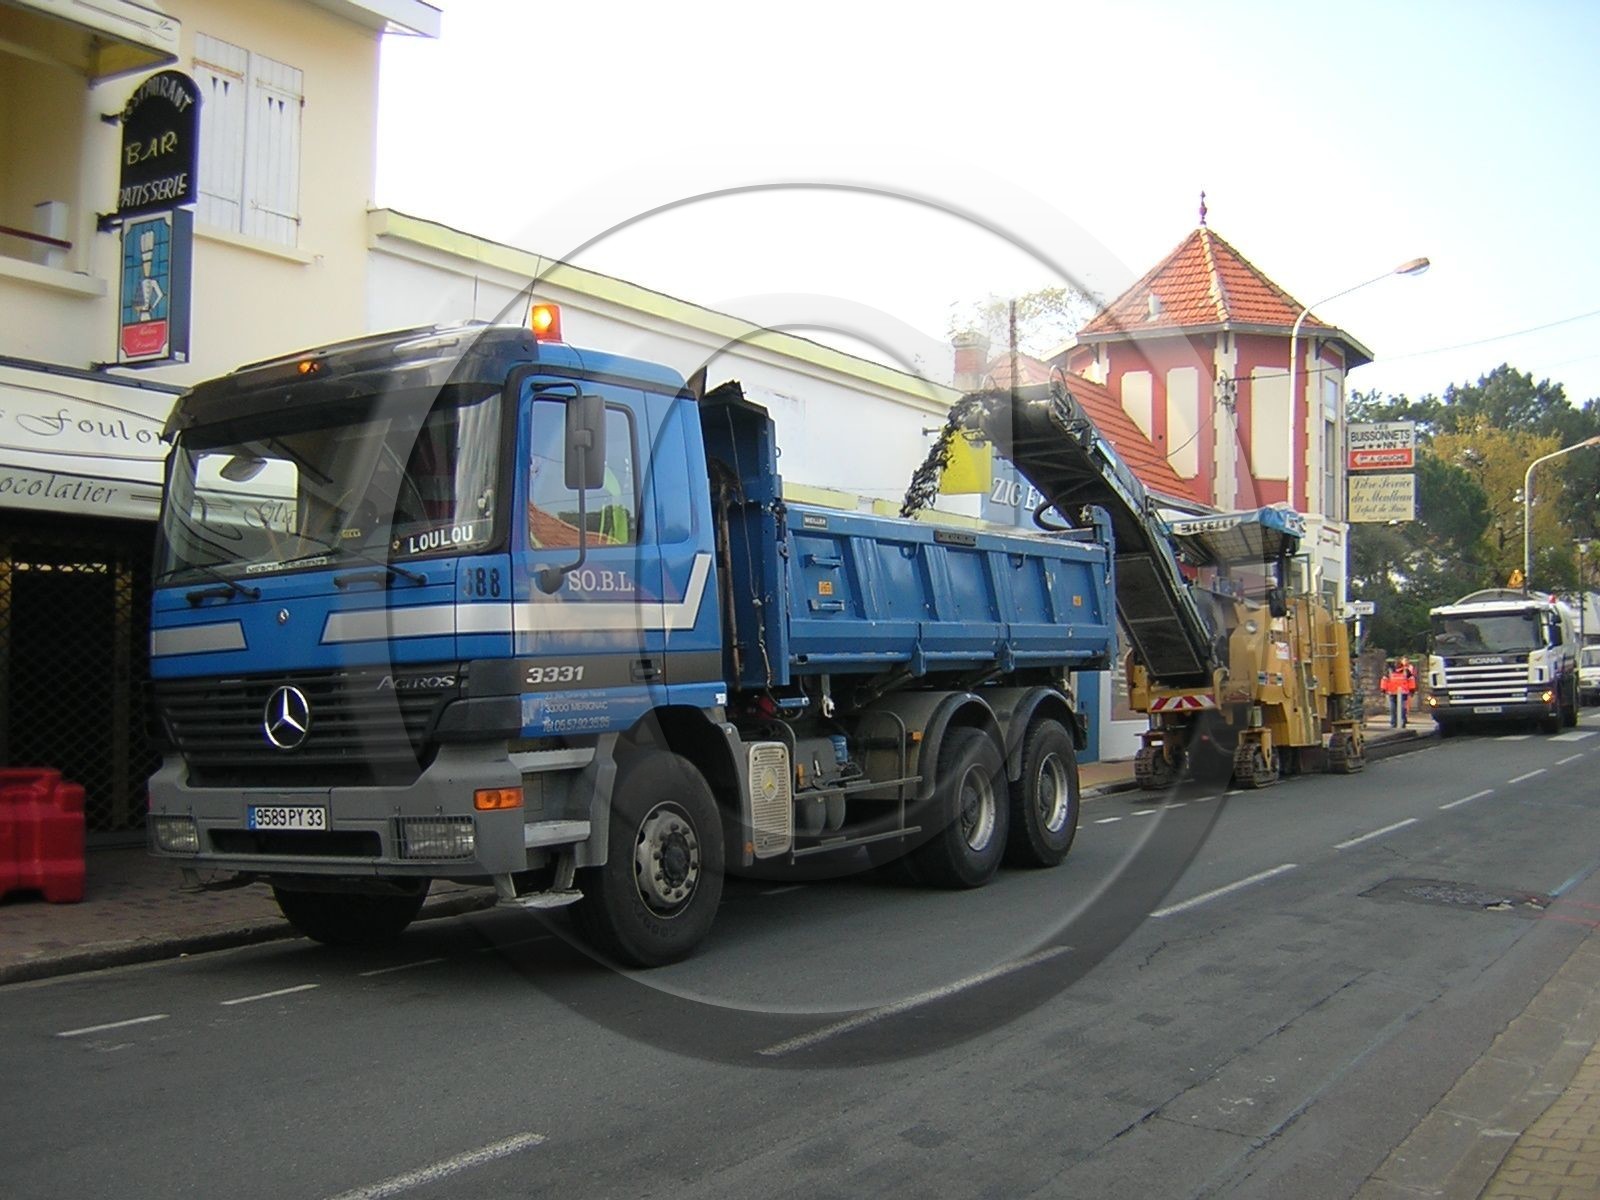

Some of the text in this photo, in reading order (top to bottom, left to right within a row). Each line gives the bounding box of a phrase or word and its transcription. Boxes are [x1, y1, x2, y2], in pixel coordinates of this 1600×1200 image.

[125, 131, 178, 165] BAR
[120, 173, 187, 207] PATISSERIE
[1351, 429, 1410, 442] BUISSONNETS
[990, 477, 1022, 508] ZIG
[409, 525, 474, 553] LOULOU
[1468, 656, 1503, 665] SCANIA
[526, 665, 585, 684] 3331
[256, 809, 323, 826] 9589 PY 33
